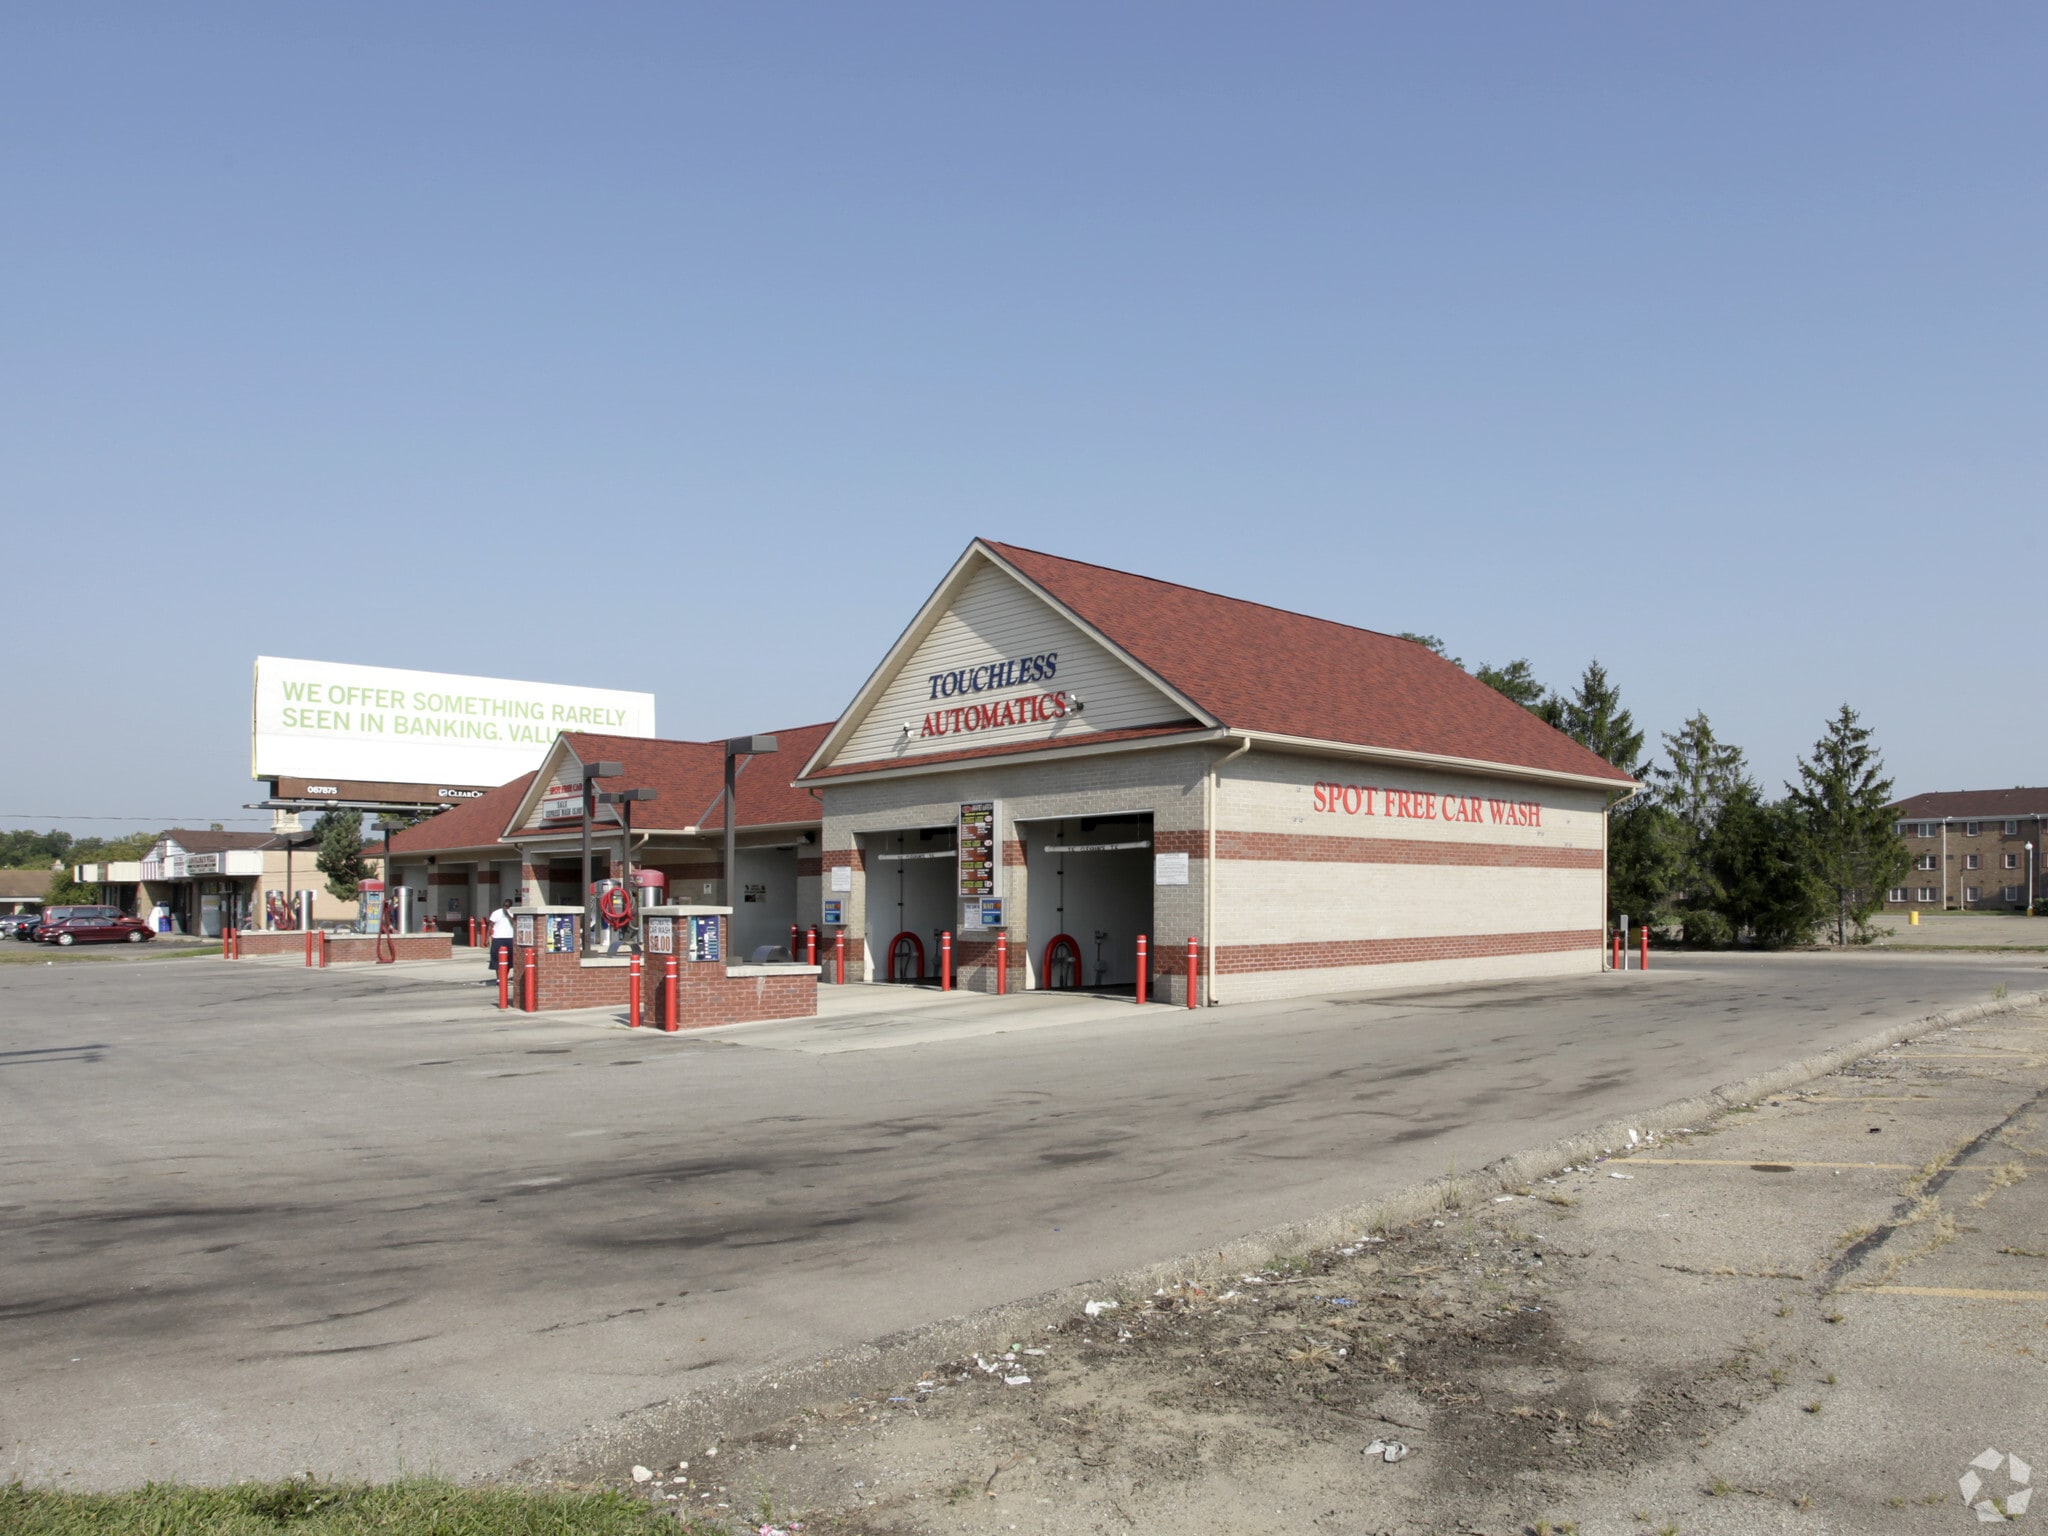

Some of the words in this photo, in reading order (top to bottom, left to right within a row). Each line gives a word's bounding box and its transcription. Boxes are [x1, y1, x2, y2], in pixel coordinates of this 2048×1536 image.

[928, 652, 1058, 700] TOUCHLESS
[282, 681, 322, 703] WE
[328, 685, 405, 709] OFFER
[413, 692, 544, 720] SOMETHING
[552, 704, 626, 727] RARELY
[282, 707, 350, 731] SEEN
[361, 713, 383, 733] IN
[394, 715, 503, 741] BANKING.
[509, 724, 585, 745] VALU
[920, 691, 1066, 738] AUTOMATICS
[573, 783, 582, 791] CAR
[1313, 781, 1378, 815] SPOT
[1384, 788, 1437, 820] FREE
[1442, 794, 1484, 823] CAR
[1488, 798, 1541, 827] WASH
